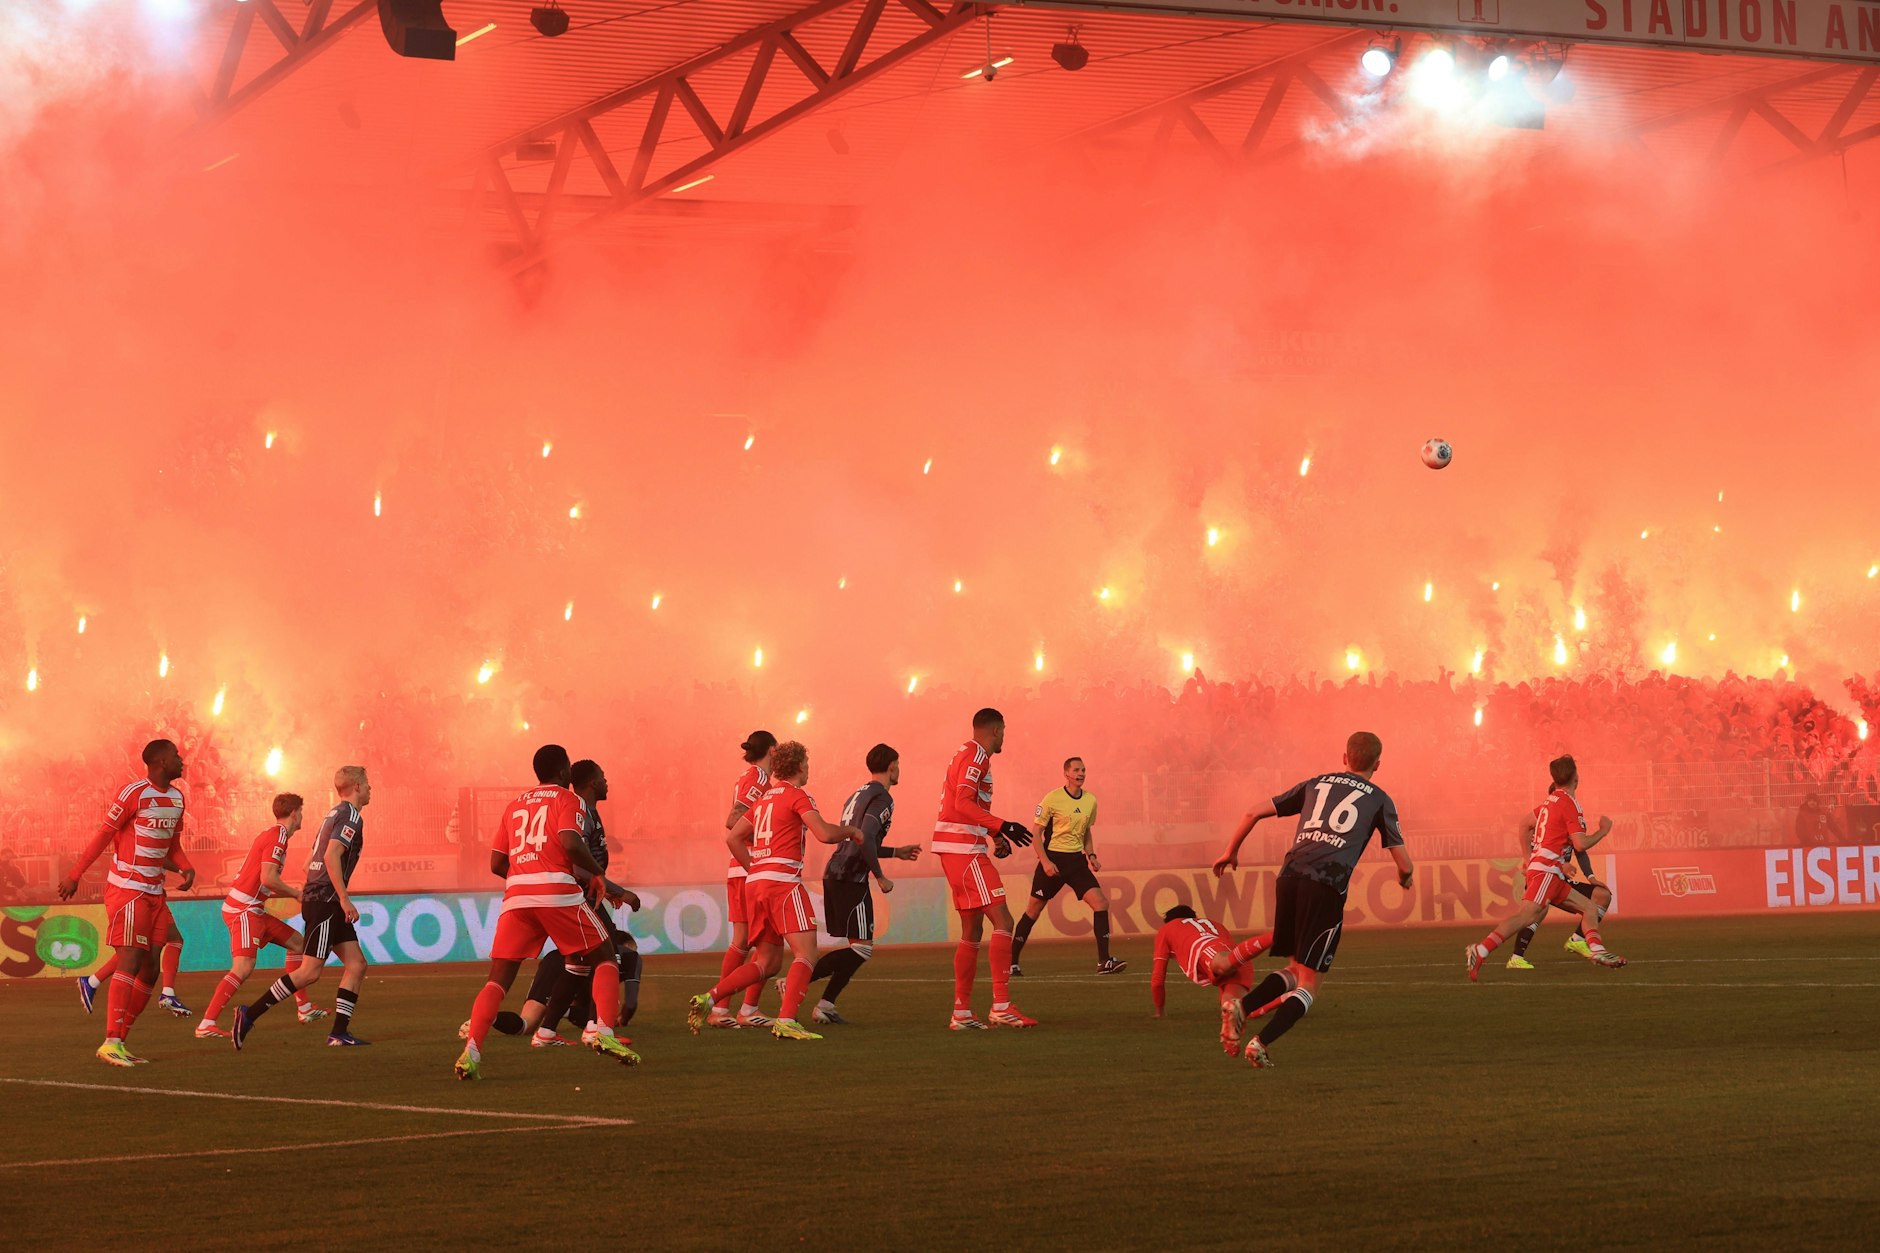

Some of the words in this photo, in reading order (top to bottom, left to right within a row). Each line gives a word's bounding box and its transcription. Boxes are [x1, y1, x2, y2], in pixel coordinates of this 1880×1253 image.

[1586, 0, 1797, 46] STADION
[533, 789, 559, 798] UNION
[1320, 775, 1375, 795] LARSSON
[158, 816, 178, 828] rais
[753, 802, 774, 848] 14
[841, 792, 861, 827] 4
[1303, 782, 1366, 834] 16
[510, 804, 549, 857] 34
[364, 861, 435, 874] MOMME
[517, 851, 539, 865] NSOKI
[1765, 845, 1880, 908] EISER
